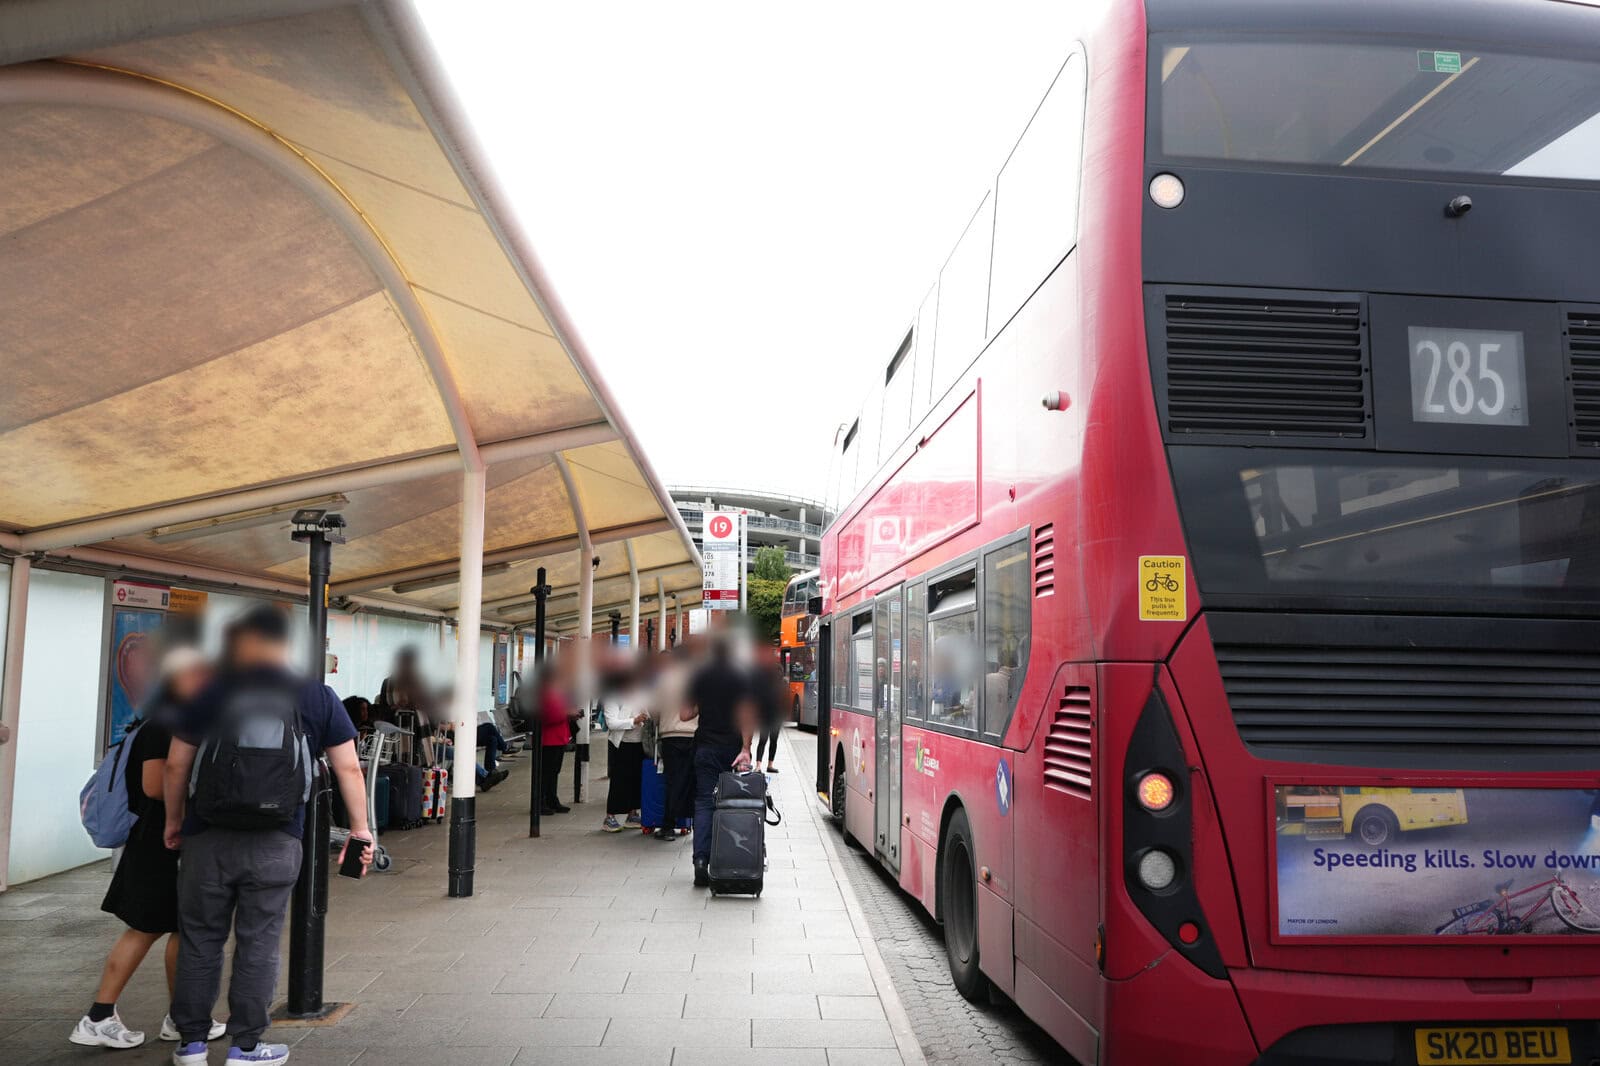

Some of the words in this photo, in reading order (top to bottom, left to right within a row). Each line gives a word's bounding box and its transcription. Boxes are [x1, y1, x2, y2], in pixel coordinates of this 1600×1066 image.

[1416, 340, 1505, 416] 285
[714, 522, 728, 533] 19
[1144, 560, 1181, 568] Caution
[1313, 848, 1417, 872] Speeding
[1424, 850, 1475, 868] kills.
[1483, 850, 1536, 868] Slow
[1427, 1031, 1499, 1059] SK20
[1504, 1031, 1558, 1058] BEU
